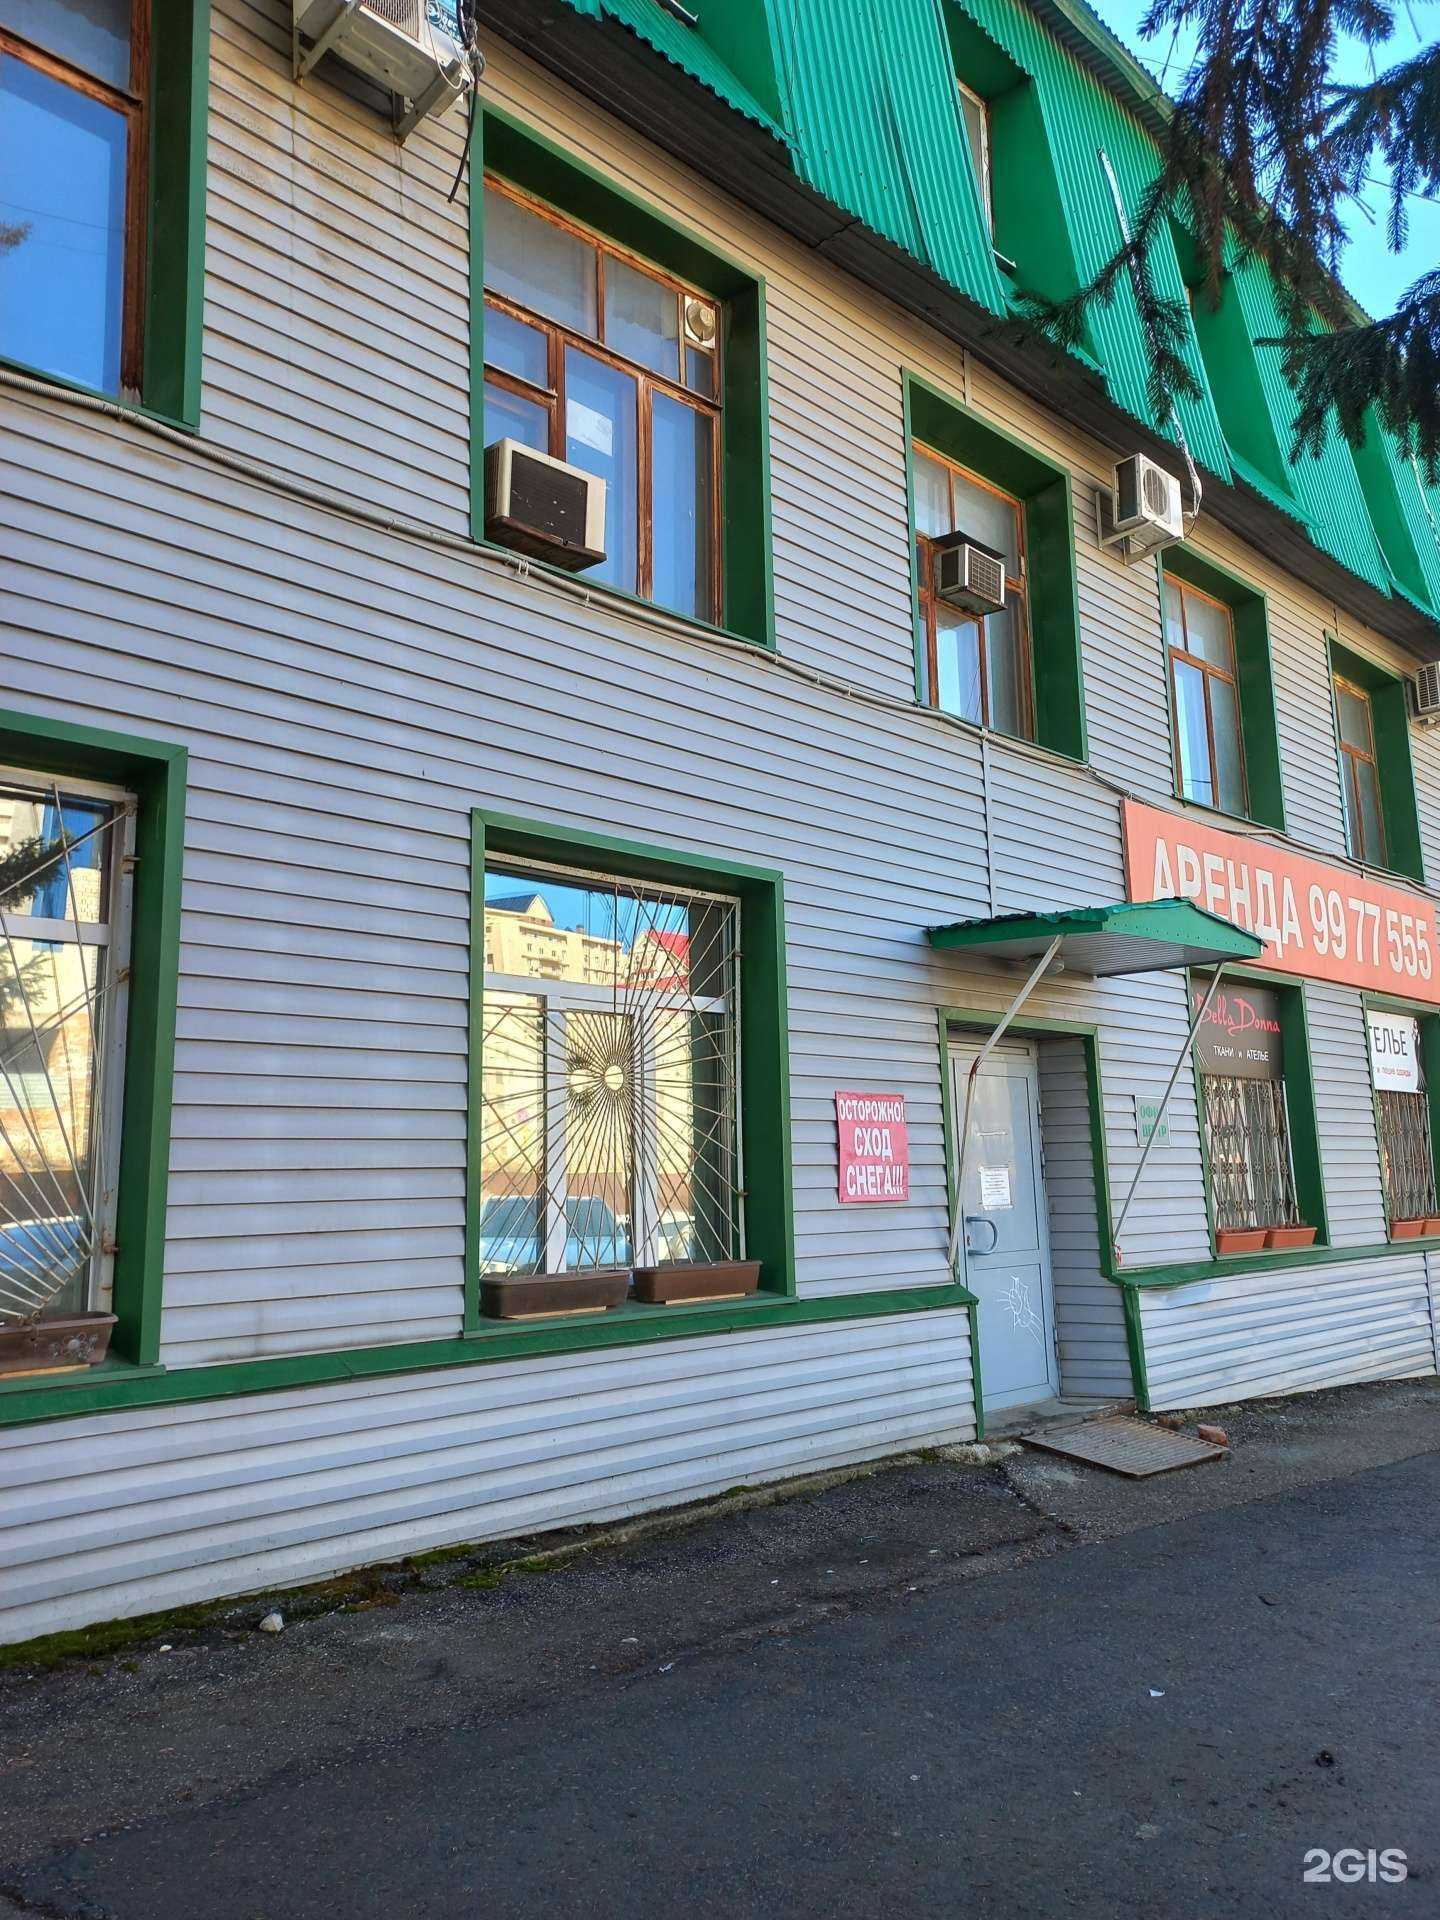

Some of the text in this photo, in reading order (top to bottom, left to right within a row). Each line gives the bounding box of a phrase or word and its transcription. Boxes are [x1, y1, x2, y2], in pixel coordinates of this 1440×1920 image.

[1153, 837, 1304, 959] АРЕНДА
[1228, 998, 1280, 1037] Donna
[1213, 1045, 1235, 1058] ТКАНИ
[1247, 1049, 1270, 1062] АТЕЛЬЕ
[1368, 1026, 1408, 1057] ЕЛЬЕ
[838, 1099, 905, 1123] ОСТОРОЖНО!
[854, 1127, 893, 1162] СХОД
[846, 1164, 904, 1196] СНЕГА!!!
